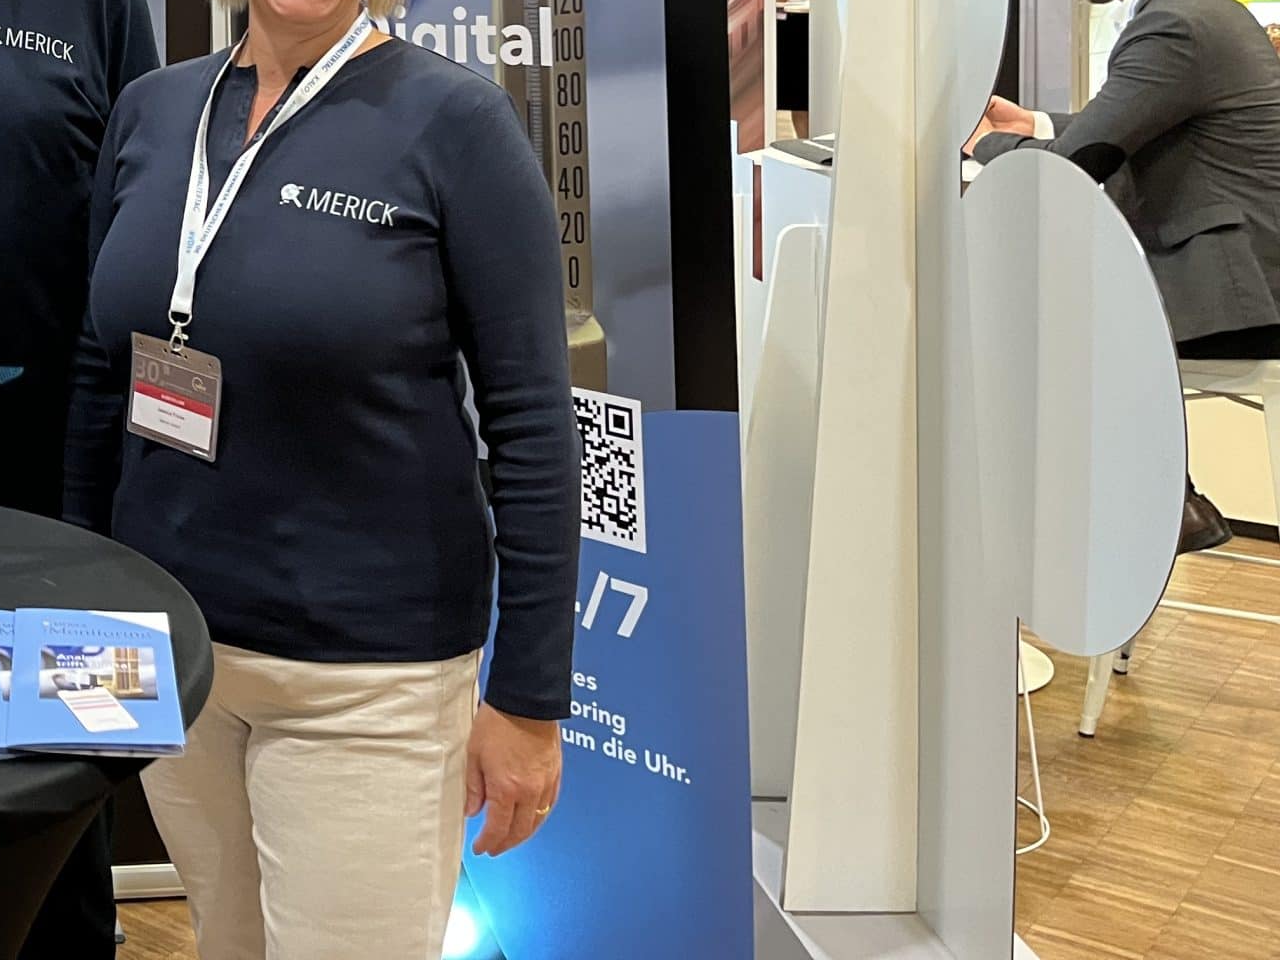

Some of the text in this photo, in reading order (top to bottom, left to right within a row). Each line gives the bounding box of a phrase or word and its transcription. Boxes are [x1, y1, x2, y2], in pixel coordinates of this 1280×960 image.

[5, 26, 74, 64] MERICK
[552, 26, 584, 62] 100
[557, 72, 581, 107] 80
[558, 121, 582, 156] 60
[558, 166, 584, 200] 40
[306, 188, 399, 226] MERICK
[560, 211, 585, 245] 20
[568, 256, 580, 289] 0
[562, 725, 691, 786] um die Uhr.
